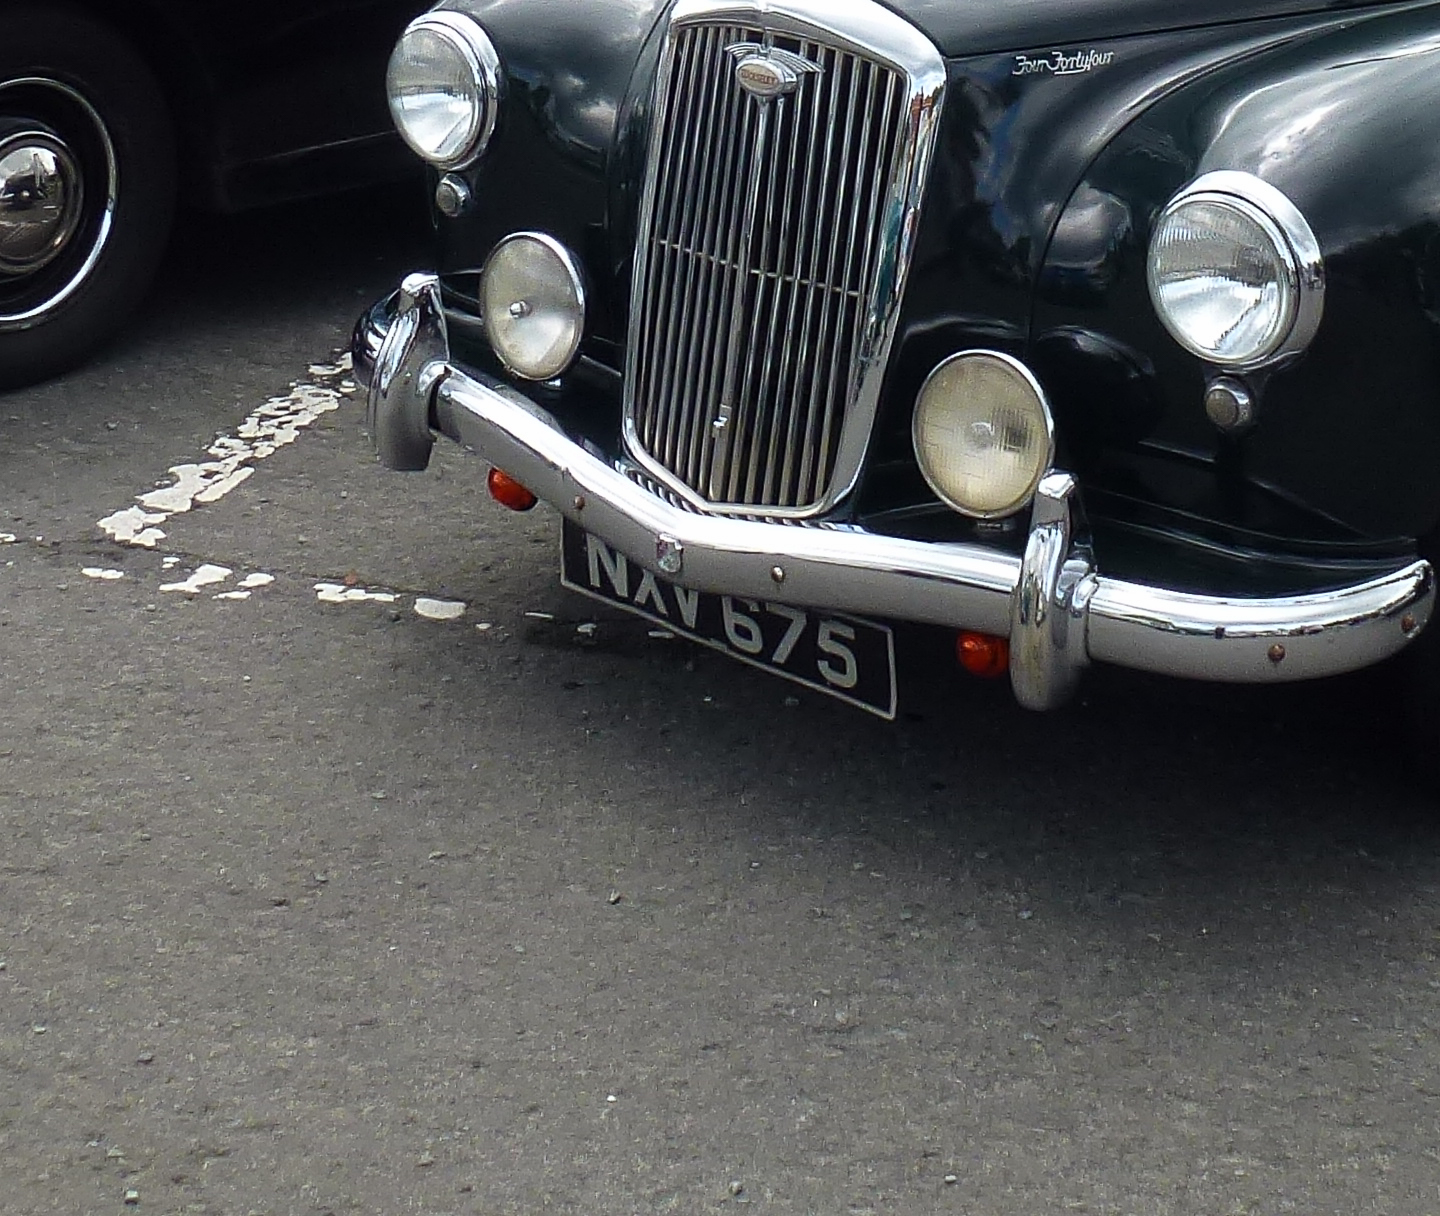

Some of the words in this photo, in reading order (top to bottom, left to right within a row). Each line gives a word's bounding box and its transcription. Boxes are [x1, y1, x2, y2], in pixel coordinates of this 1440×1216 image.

[1012, 55, 1047, 75] Four
[1051, 49, 1115, 76] Fortyfour
[720, 595, 859, 689] 675
